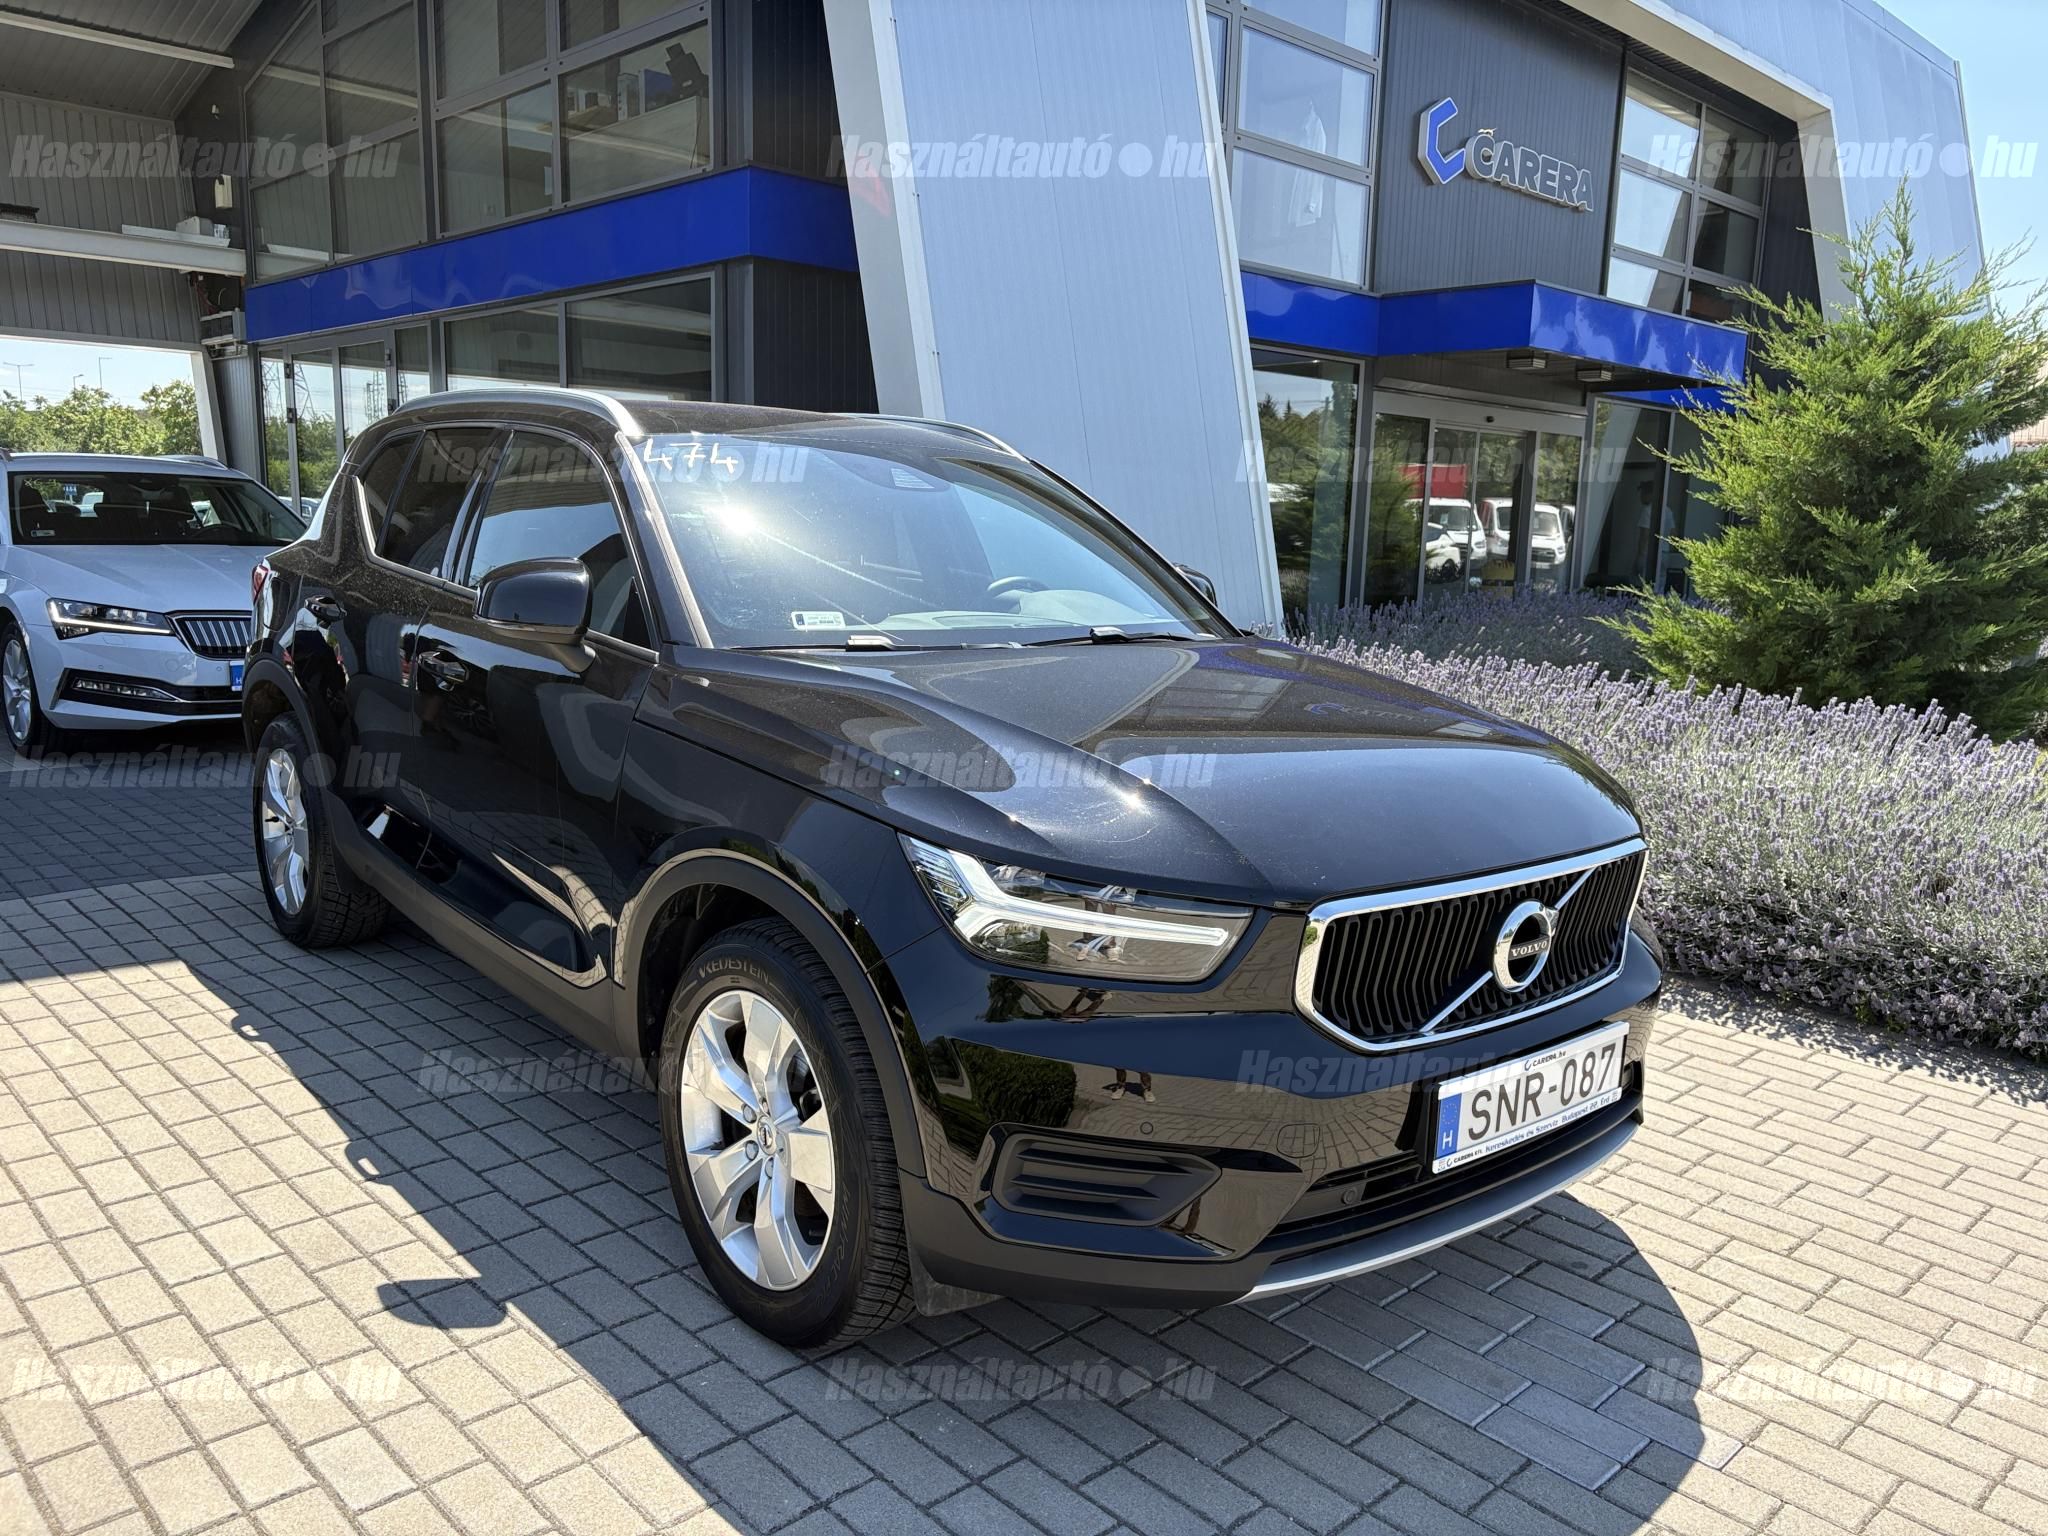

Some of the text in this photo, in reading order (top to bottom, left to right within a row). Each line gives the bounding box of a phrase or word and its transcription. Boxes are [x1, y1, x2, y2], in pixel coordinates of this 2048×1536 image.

[1466, 134, 1593, 212] CARERA
[643, 438, 739, 474] 474
[1511, 940, 1548, 957] VOLVO
[698, 957, 769, 985] VREDESTEIN
[1468, 1042, 1616, 1141] SNR-087
[1442, 1130, 1453, 1150] H
